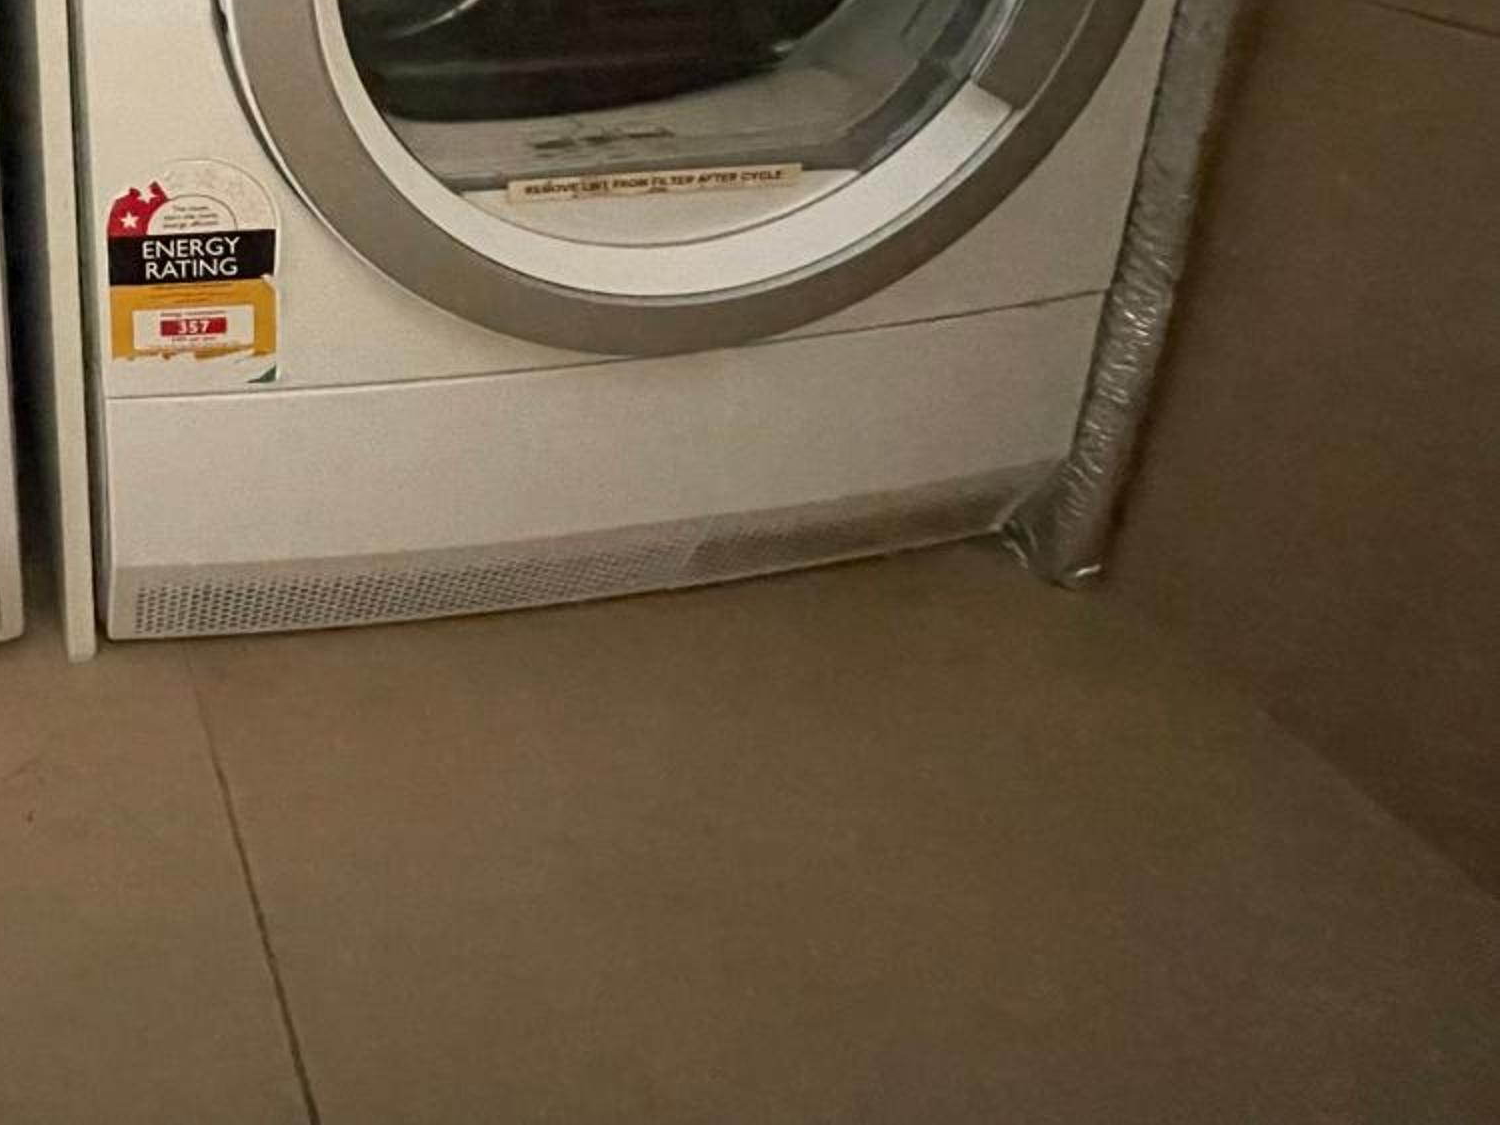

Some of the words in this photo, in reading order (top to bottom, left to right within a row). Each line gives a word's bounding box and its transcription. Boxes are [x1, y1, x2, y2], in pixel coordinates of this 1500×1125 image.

[524, 181, 577, 195] REMOVE
[611, 177, 649, 190] FROM
[651, 174, 694, 188] FILTER
[697, 172, 738, 185] AFTER
[740, 169, 783, 182] CYCLE
[142, 236, 241, 259] ENERGY
[145, 257, 238, 279] RATING
[178, 320, 210, 334] 357
